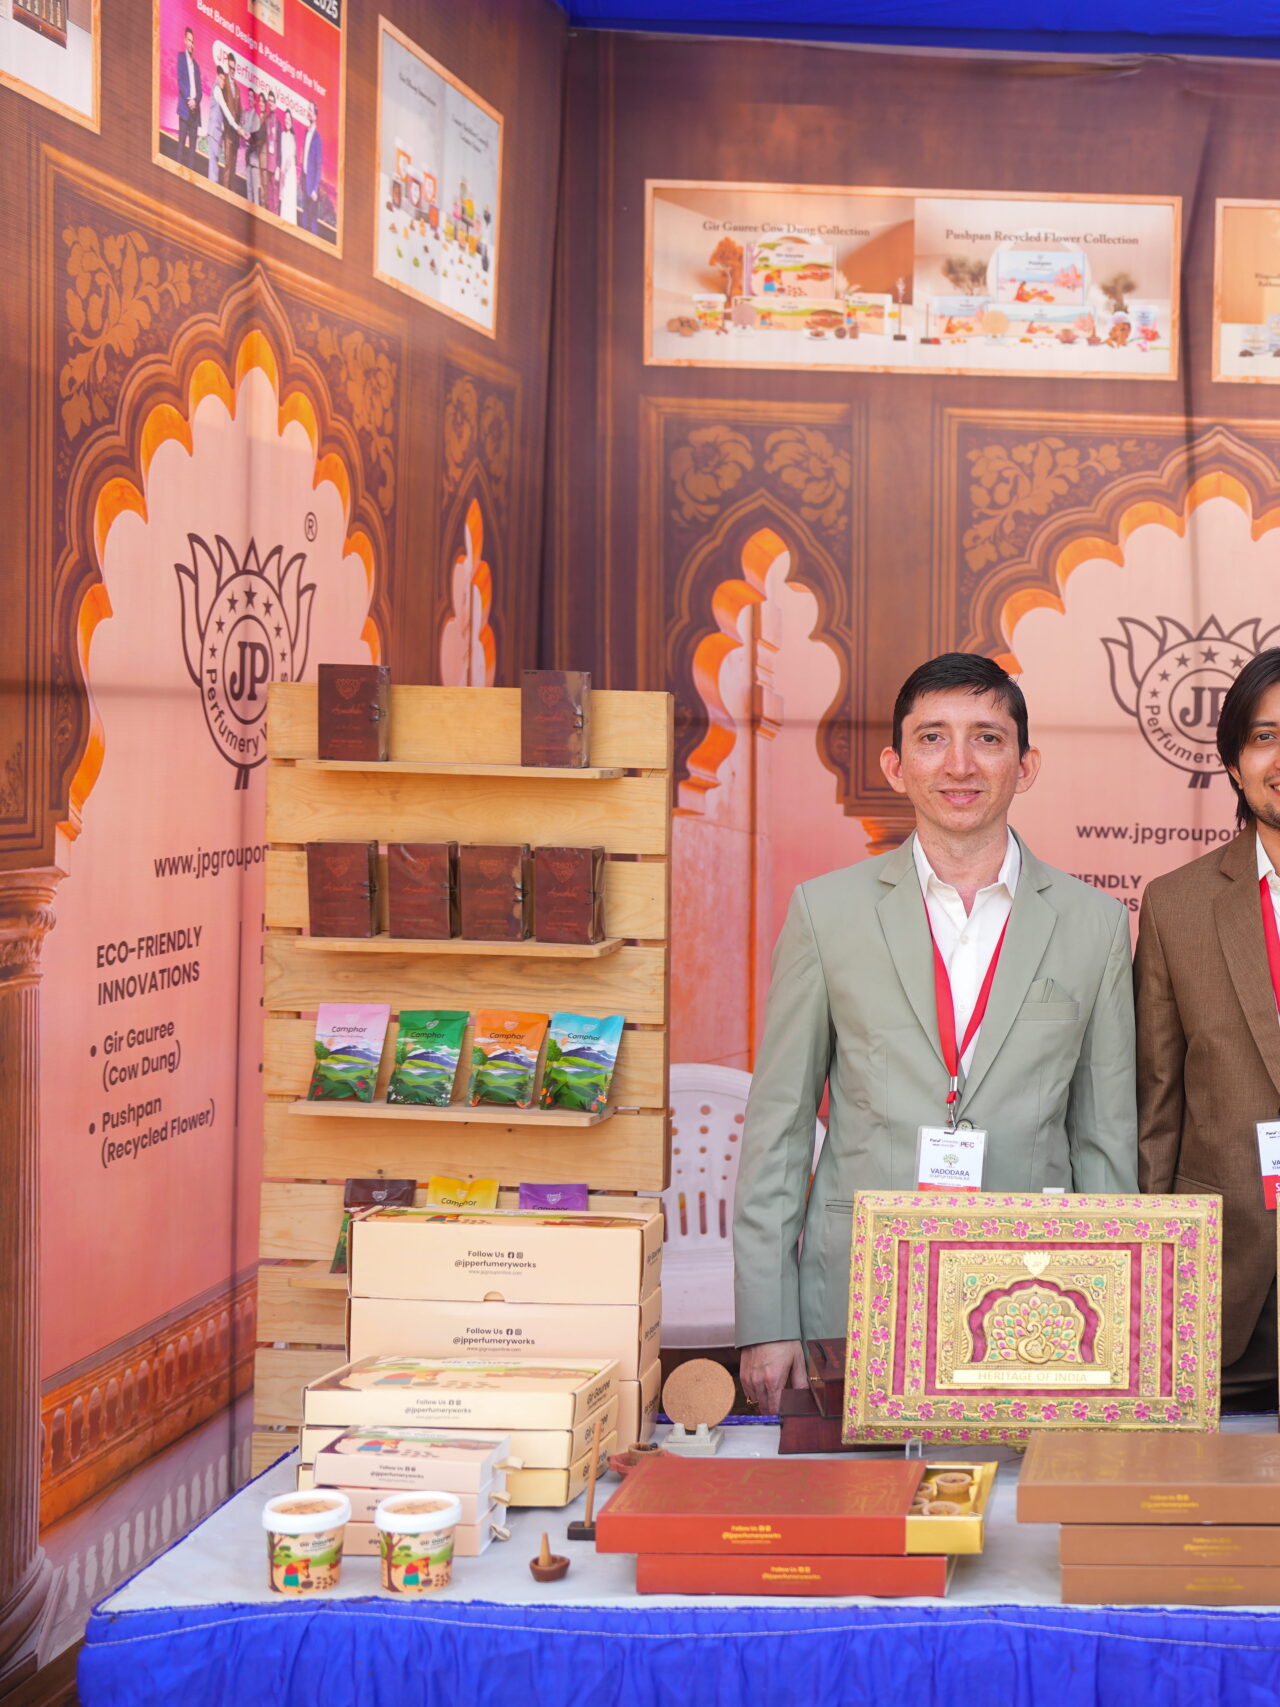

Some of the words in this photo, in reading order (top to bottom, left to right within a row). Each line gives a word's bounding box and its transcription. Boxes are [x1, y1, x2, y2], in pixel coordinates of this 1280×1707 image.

[196, 0, 214, 19] Best
[214, 9, 235, 33] Brand
[264, 45, 295, 79] Packaging
[703, 221, 721, 232] Gir
[722, 221, 759, 233] Gauree
[761, 222, 784, 234] Cow
[786, 223, 816, 236] Dung
[818, 224, 871, 237] Collection
[945, 229, 991, 242] Pushpan
[994, 230, 1041, 244] Recycled
[1044, 231, 1081, 244] Flower
[1083, 233, 1139, 246] Collection
[229, 640, 270, 701] JP
[205, 667, 259, 757] Perfumery
[96, 925, 202, 968] ECO-FRIENDLY
[97, 961, 200, 1006] INNOVATIONS
[103, 1031, 125, 1055] Gir
[127, 1021, 175, 1048] Gauree
[331, 1026, 368, 1034] Camphor
[410, 1031, 446, 1039] Camphor
[489, 1032, 525, 1040] Camphor
[567, 1033, 601, 1041] Camphor
[102, 1060, 139, 1093] (Cow
[142, 1040, 181, 1075] Dung)
[102, 1097, 162, 1132] Pushpan
[101, 1125, 168, 1169] (Recycled
[171, 1098, 216, 1139] Flower)
[930, 1168, 970, 1177] VADODARA
[468, 1250, 493, 1258] Follow
[454, 1259, 537, 1270] @jpperfumeryworks
[466, 1327, 492, 1335] Follow
[452, 1336, 536, 1347] @jpperfumeryworks
[978, 1371, 1034, 1381] HERITAGE
[1037, 1372, 1050, 1381] OF
[1055, 1373, 1088, 1382] INDIA
